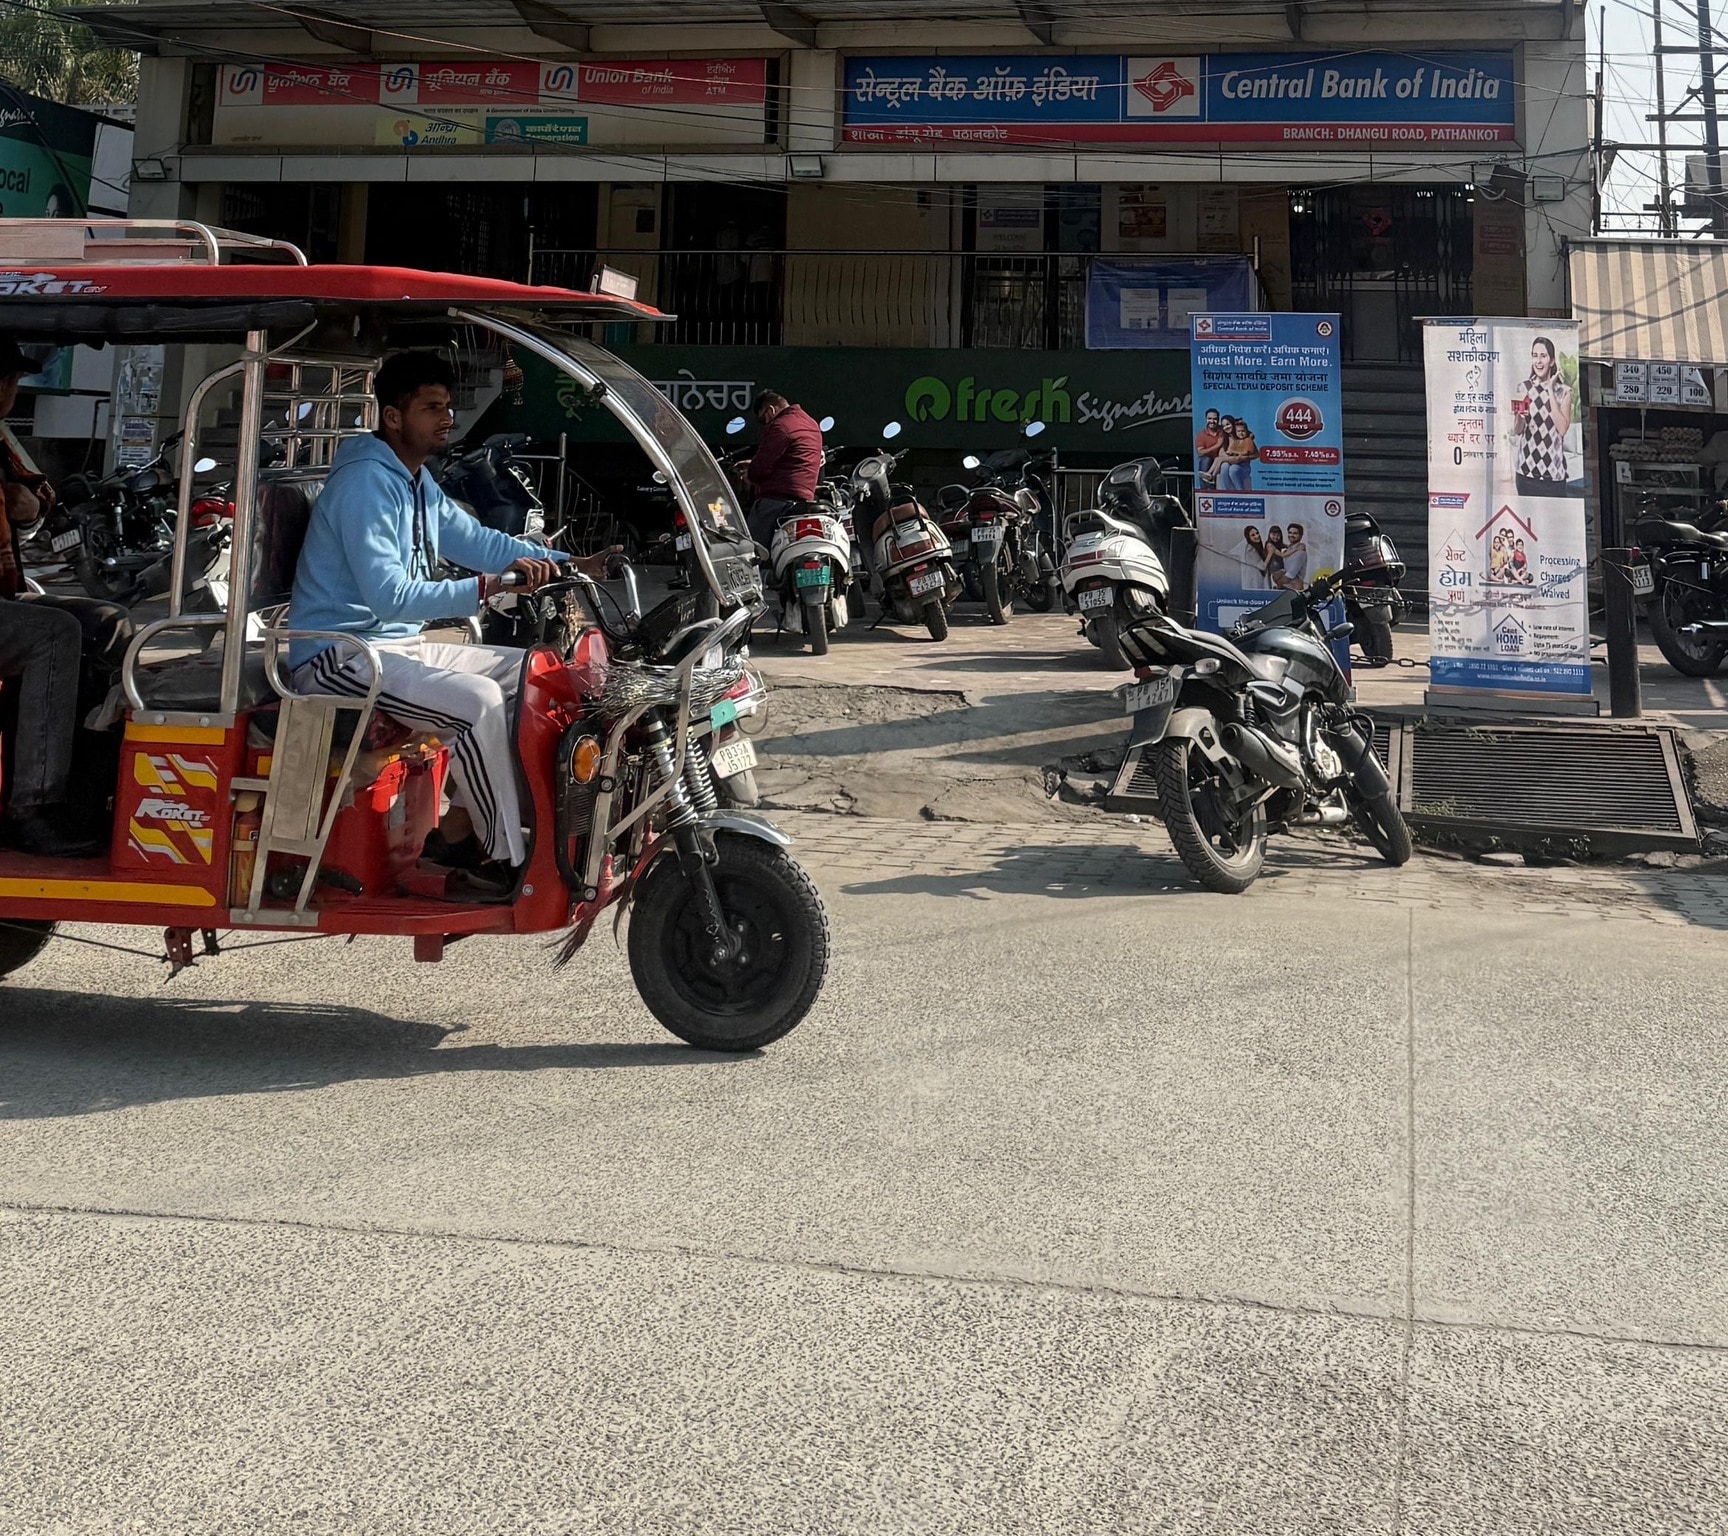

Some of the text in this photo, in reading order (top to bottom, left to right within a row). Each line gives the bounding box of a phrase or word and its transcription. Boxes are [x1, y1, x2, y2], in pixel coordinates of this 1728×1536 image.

[485, 68, 512, 85] बैंक
[585, 68, 673, 84] Union Bank
[641, 84, 674, 95] of India
[855, 66, 922, 109] सेन्ट्रल
[928, 65, 968, 101] बैंक
[1031, 66, 1100, 108] इंडिया
[1221, 67, 1500, 100] Central Bank of India
[705, 86, 726, 95] ATM
[952, 125, 1008, 141] पठानकोट
[1283, 127, 1500, 142] BRANCH: DHANGU ROAD, PATHANKOT
[1458, 328, 1487, 346] महिला
[1197, 355, 1333, 368] Invest More. Earn More.
[1202, 382, 1237, 391] SPECIAL
[1259, 383, 1295, 392] DEPOSIT
[1295, 383, 1328, 392] SCHEME
[1623, 384, 1640, 394] 280
[1656, 386, 1672, 395] 220
[1689, 388, 1704, 397] 100
[956, 375, 1193, 432] fresh Signature
[1286, 408, 1312, 423] 444
[1539, 555, 1580, 568] Processing
[1438, 564, 1472, 587] होम
[1540, 588, 1570, 600] Waived
[1496, 634, 1524, 646] HOME
[1500, 645, 1521, 653] LOAN
